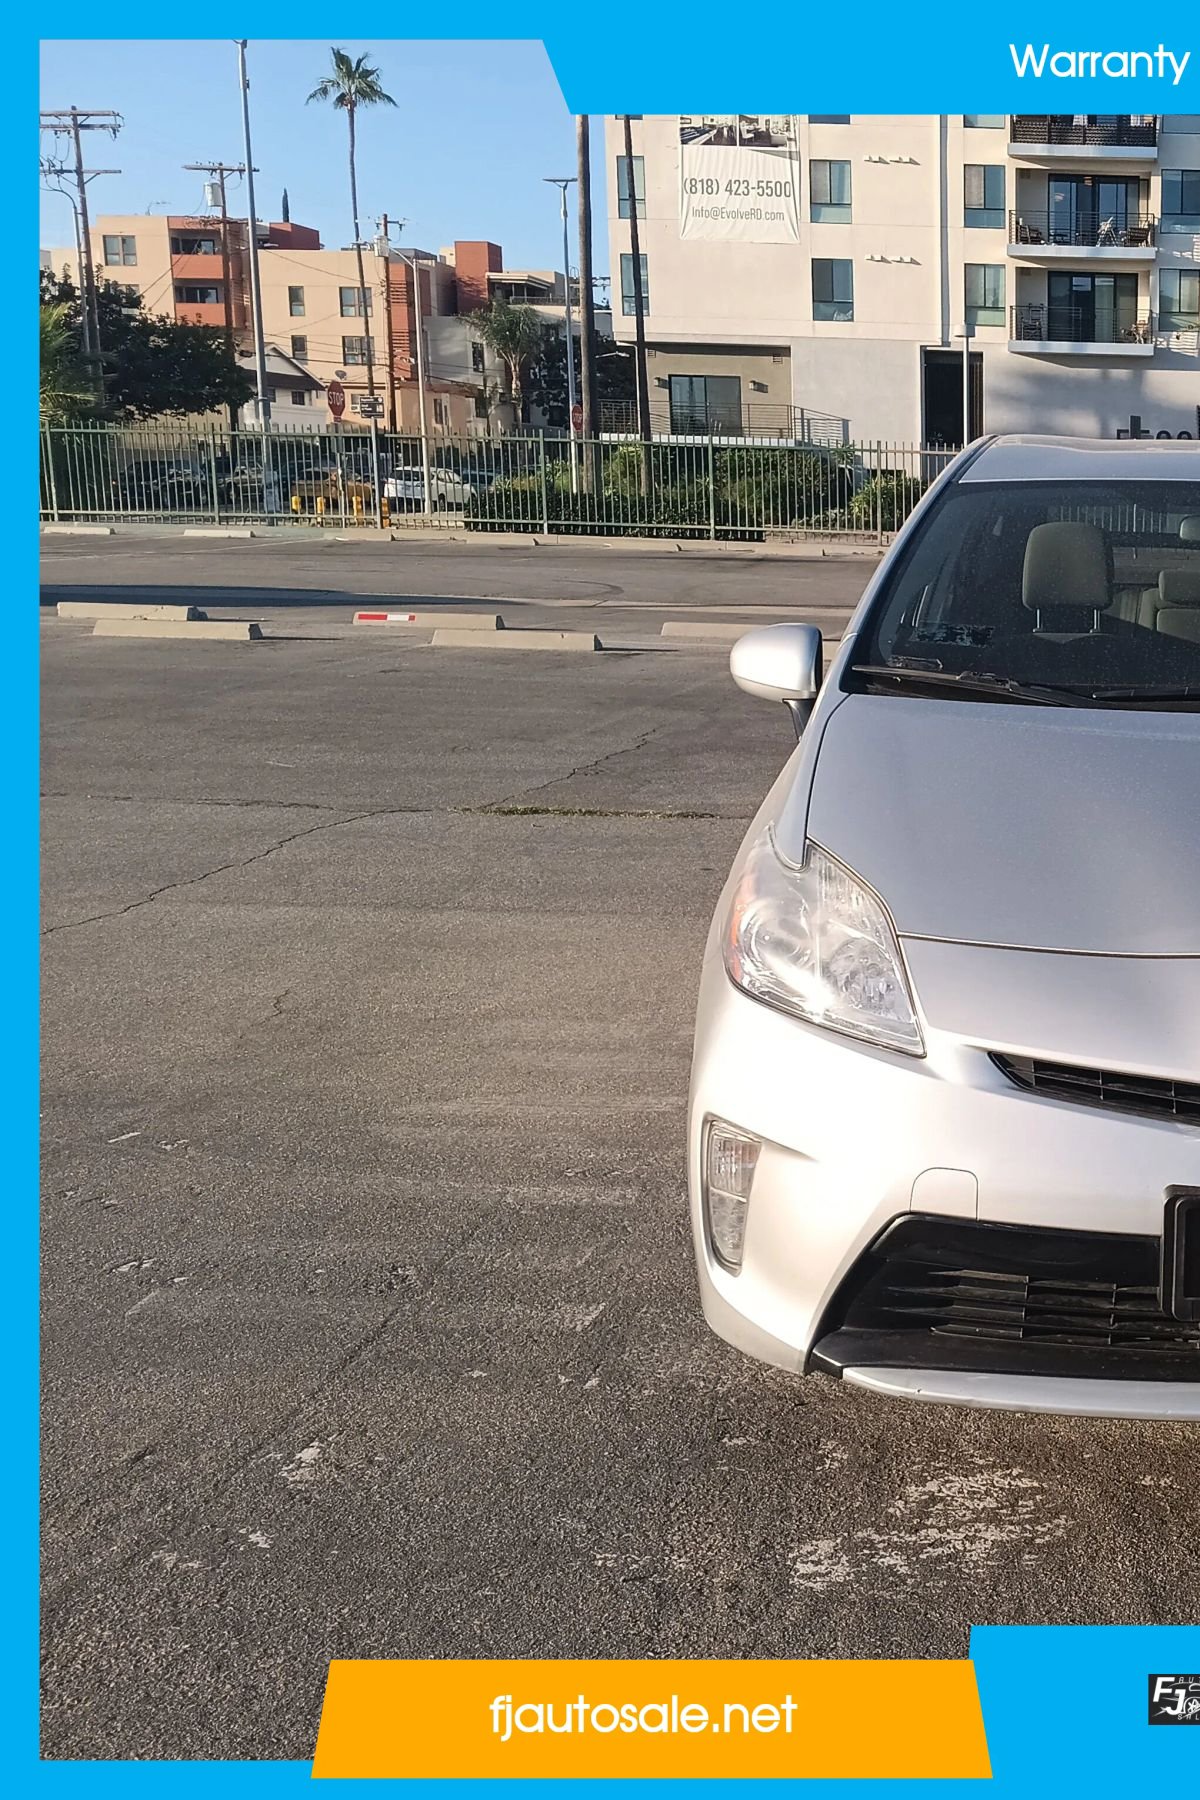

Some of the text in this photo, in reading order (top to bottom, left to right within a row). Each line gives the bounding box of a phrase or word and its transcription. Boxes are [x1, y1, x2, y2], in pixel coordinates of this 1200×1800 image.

[684, 177, 792, 197] (818) 423-5500
[692, 206, 785, 220] Info@EvolveRD.com
[329, 391, 343, 405] STOP
